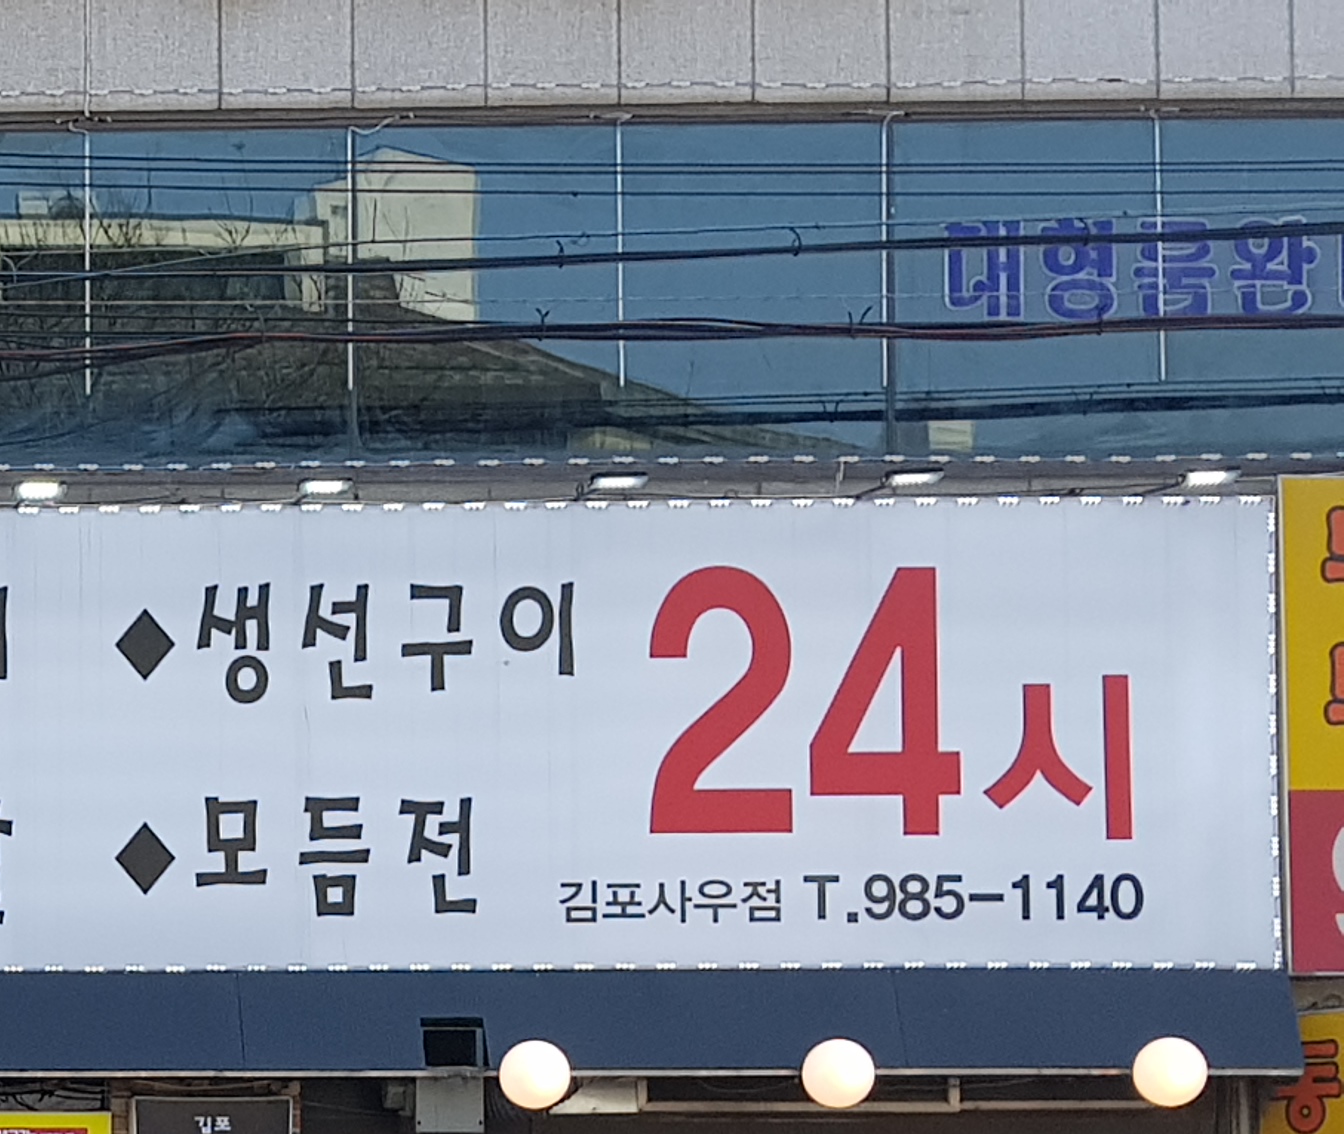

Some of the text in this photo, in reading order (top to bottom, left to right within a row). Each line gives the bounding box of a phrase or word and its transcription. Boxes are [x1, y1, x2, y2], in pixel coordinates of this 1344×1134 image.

[944, 214, 1344, 320] 대형룸완
[196, 580, 576, 704] 생선구이
[648, 565, 1133, 840] 24시
[194, 796, 478, 917] 모듬전
[557, 872, 1146, 924] 김포사우점 T.985-1140
[194, 1115, 231, 1133] 김포
